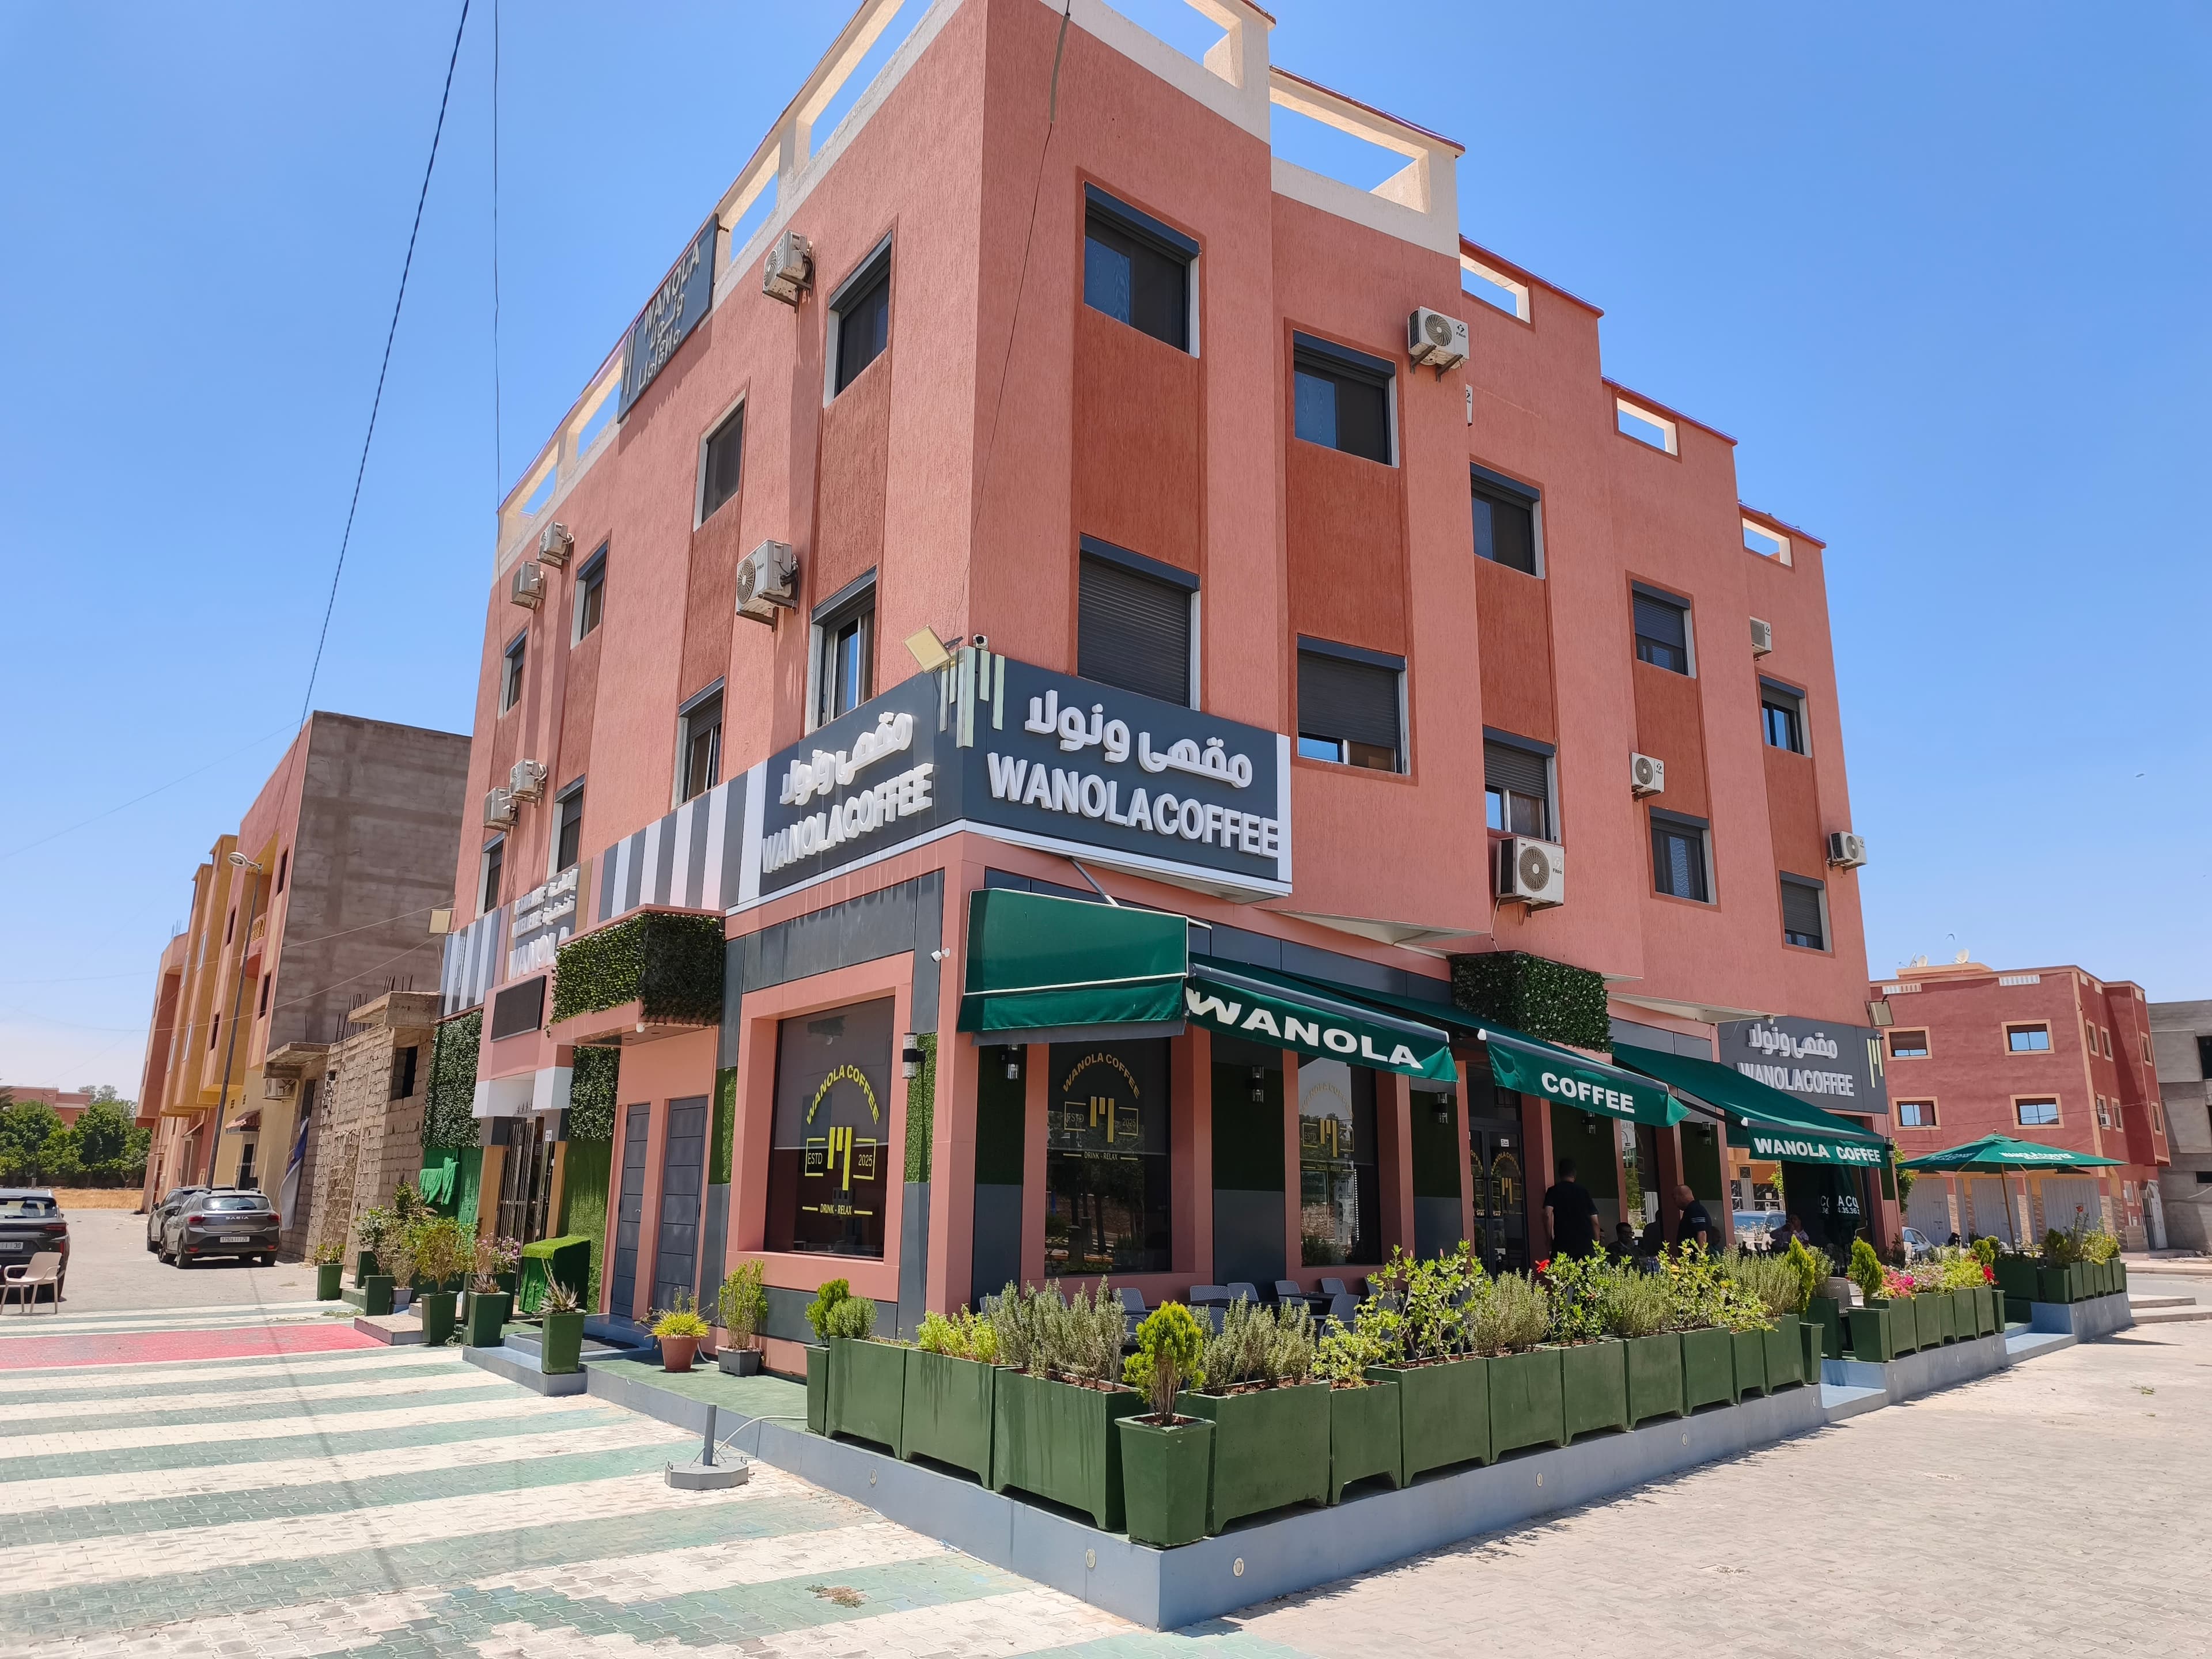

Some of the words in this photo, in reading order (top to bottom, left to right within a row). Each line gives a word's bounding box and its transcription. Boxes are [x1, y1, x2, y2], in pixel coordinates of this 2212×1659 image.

[645, 240, 700, 335] WANOLA
[1024, 690, 1131, 764] ونولا
[779, 749, 836, 806] ونولا
[1185, 986, 1423, 1069] WANOLA
[1748, 1023, 1791, 1057] ونولا
[806, 1065, 845, 1125] WANOLA
[847, 1065, 880, 1125] COFFEE
[1063, 1052, 1104, 1092] WANOLA
[1105, 1054, 1140, 1100] COFFEE
[1541, 1072, 1635, 1114] COFFEE
[1122, 1118, 1137, 1127] 2025
[808, 1153, 823, 1165] ESTD
[858, 1154, 873, 1166] 2025
[1103, 1152, 1118, 1161] RELAX
[1753, 1138, 1831, 1158] WANOLA
[1836, 1146, 1881, 1163] COFFEE
[820, 1203, 835, 1214] DRINK
[837, 1205, 853, 1215] RELAX
